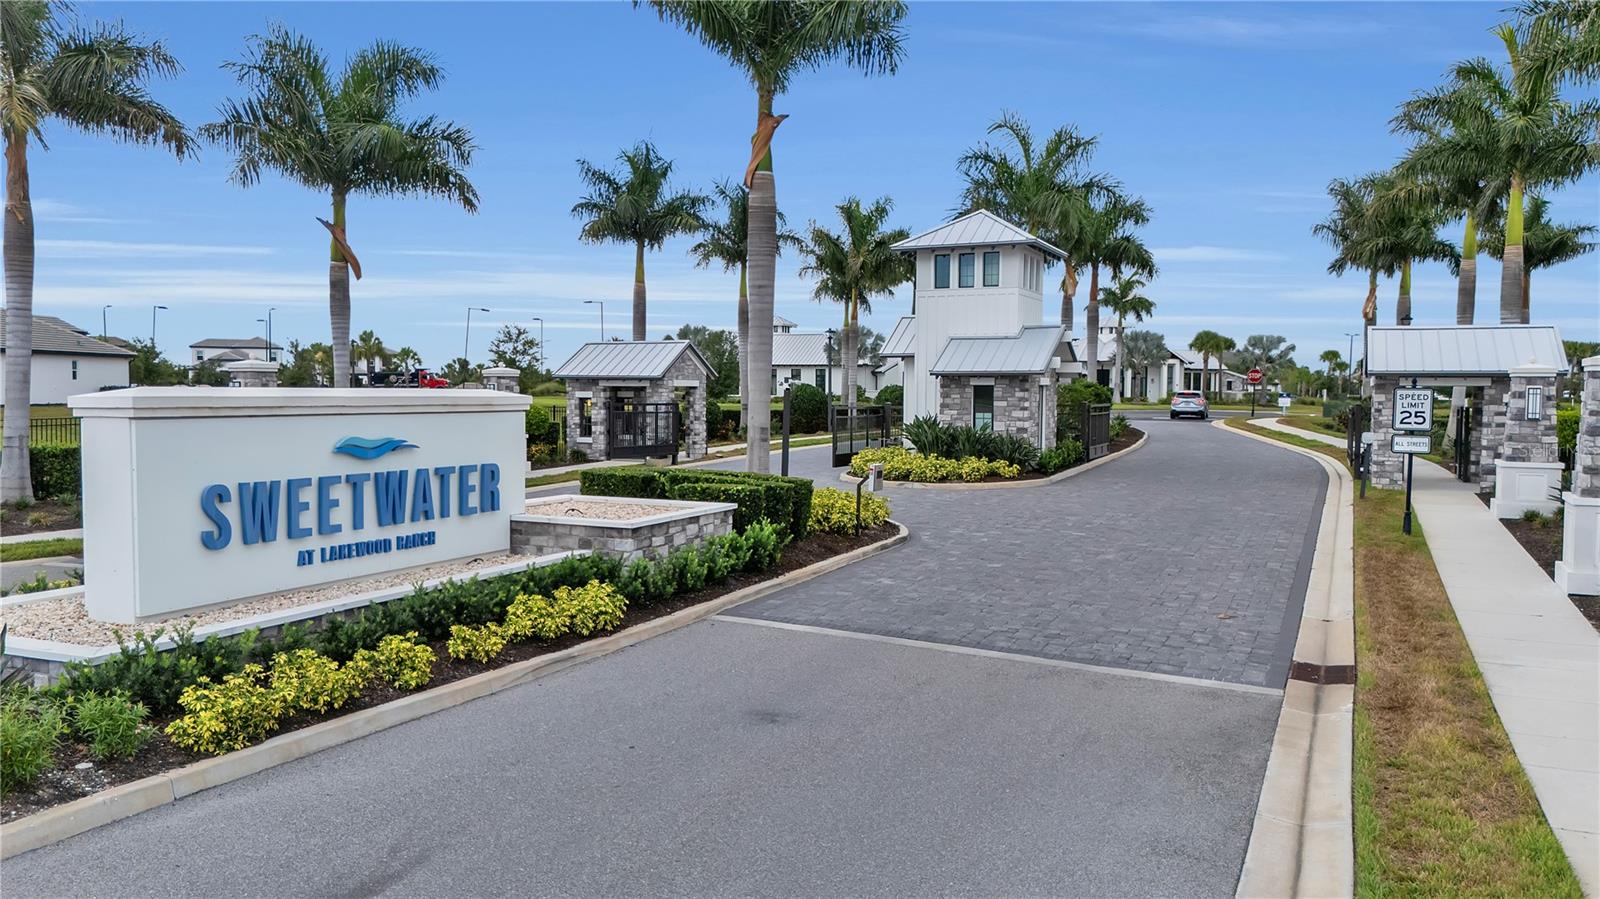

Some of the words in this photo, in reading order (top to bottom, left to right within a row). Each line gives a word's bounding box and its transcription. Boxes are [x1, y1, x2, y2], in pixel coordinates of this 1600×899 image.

[1398, 393, 1429, 401] SPEED
[1399, 410, 1426, 425] 25
[200, 463, 501, 551] SWEETWATER
[296, 549, 316, 567] AT
[320, 538, 392, 563] LAKEWOOD
[396, 531, 436, 551] RANCH
